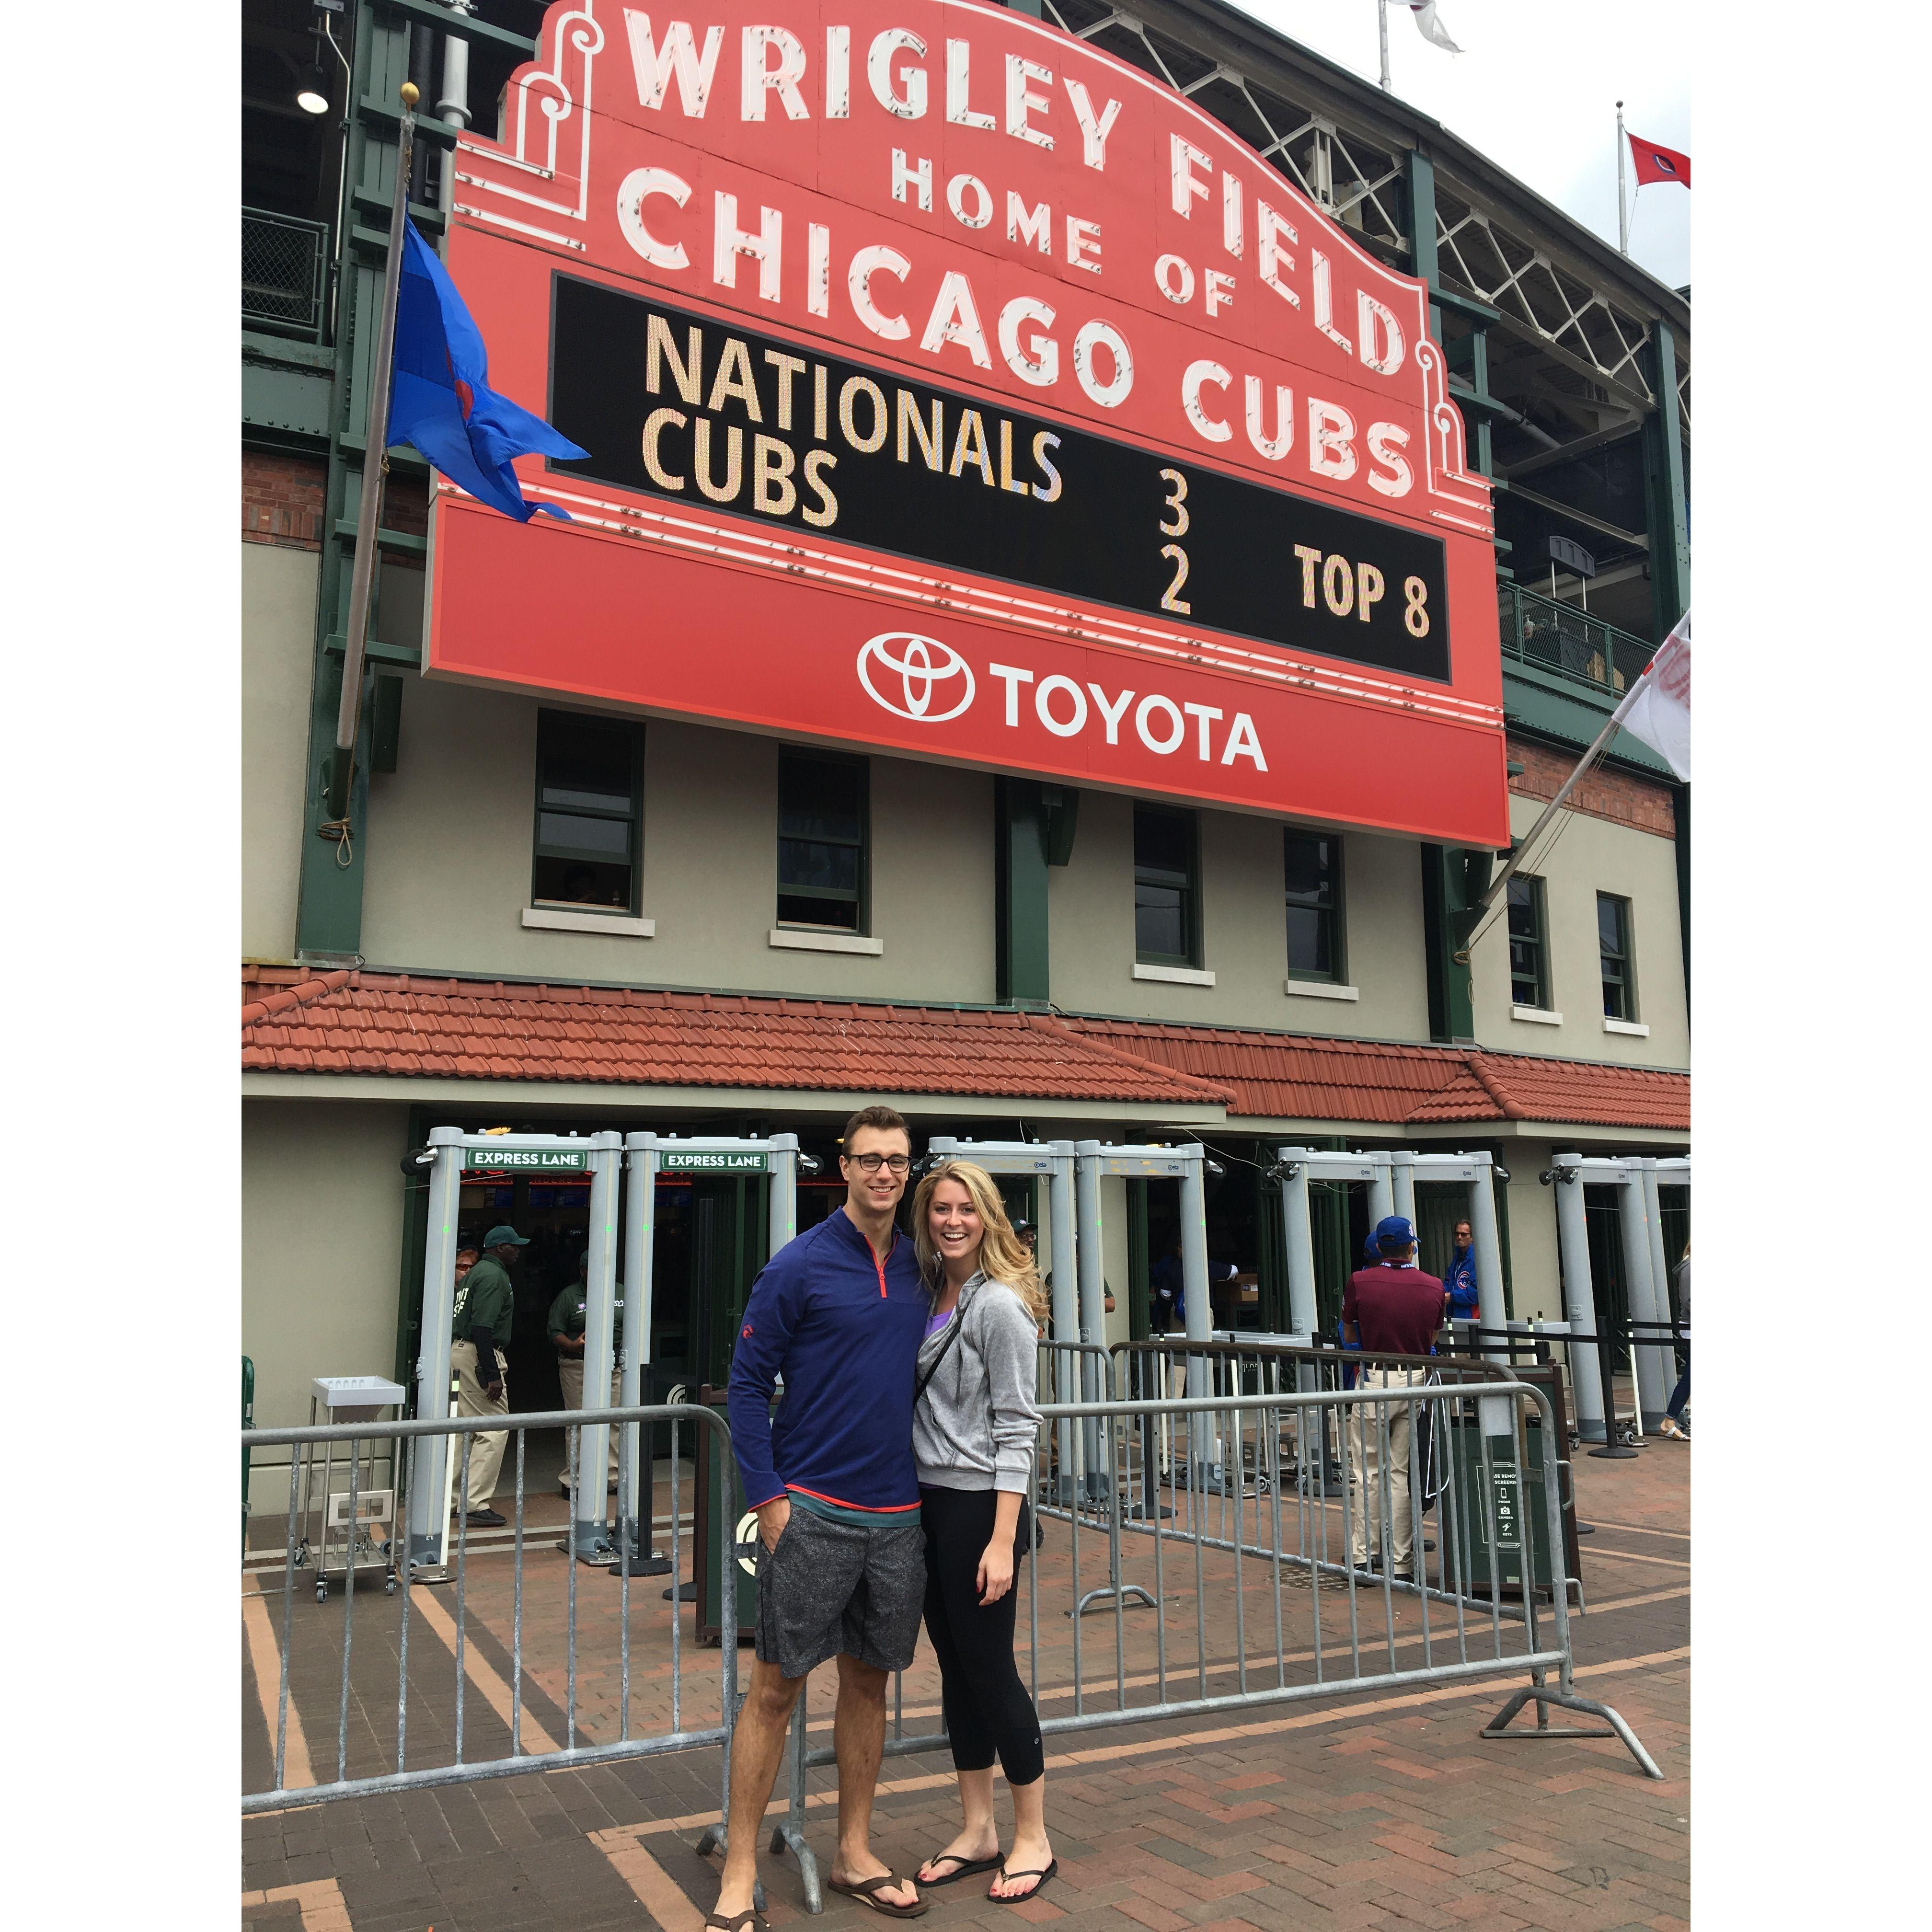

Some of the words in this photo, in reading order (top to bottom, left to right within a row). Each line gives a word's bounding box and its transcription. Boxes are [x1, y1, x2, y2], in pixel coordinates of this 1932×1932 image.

[623, 7, 1122, 172] WRIGLEY
[1170, 132, 1406, 375] FIELD
[892, 148, 1102, 274] HOME
[1154, 254, 1236, 317] OF
[617, 167, 1134, 408] CHICAGO
[1182, 360, 1414, 497] CUBS
[646, 313, 1062, 502] NATIONALS
[1159, 468, 1189, 537] 3
[642, 407, 838, 527] CUBS
[1160, 544, 1191, 615] 2
[1294, 543, 1385, 622] TOP
[1404, 575, 1430, 638] 8
[989, 662, 1269, 772] TOYOTA
[475, 1152, 539, 1165] EXPRESS
[542, 1154, 579, 1165] LANE
[668, 1155, 725, 1167] EXPRESS
[728, 1156, 761, 1167] LANE
